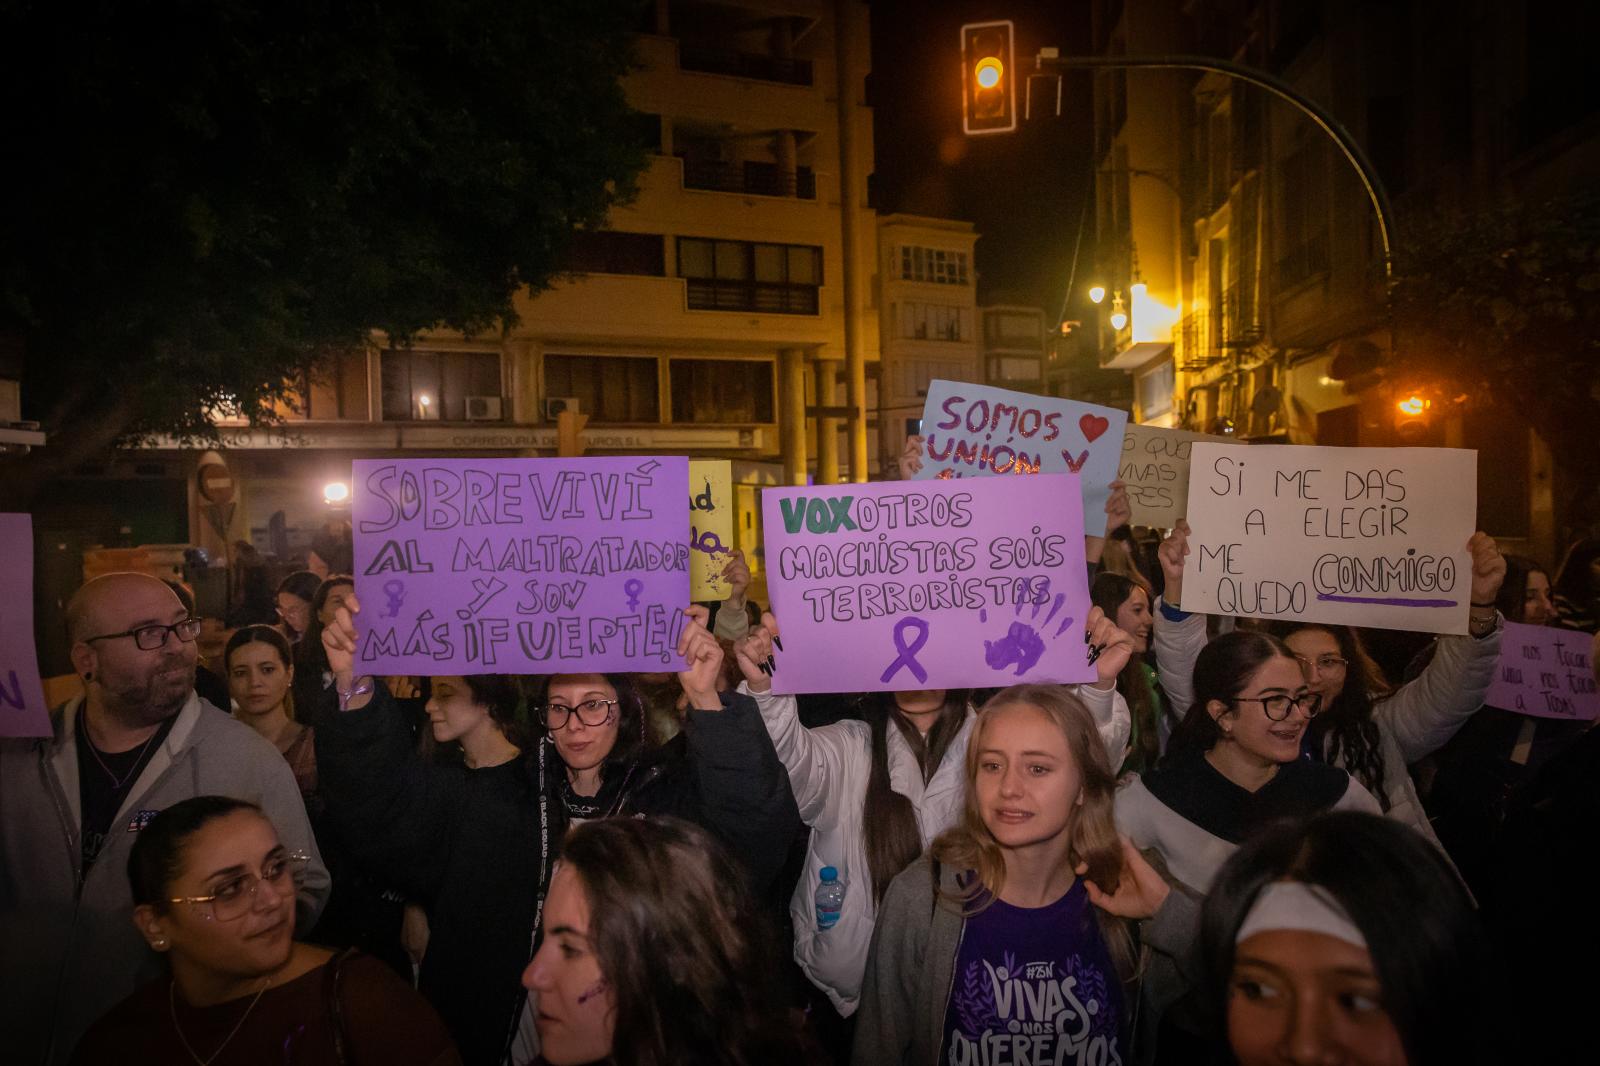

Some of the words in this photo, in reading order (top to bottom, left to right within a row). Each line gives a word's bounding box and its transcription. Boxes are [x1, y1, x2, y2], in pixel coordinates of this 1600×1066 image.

[937, 396, 1062, 441] SOMOS
[927, 433, 1041, 475] UNIÓN
[360, 459, 662, 534] SOBREVIVÍ
[1275, 469, 1322, 500] ME
[1345, 469, 1406, 502] DAS
[1245, 509, 1266, 536] A
[364, 539, 433, 576] AL
[451, 534, 690, 576] MALTRATADOR
[1199, 543, 1243, 575] ME
[468, 576, 508, 614] Y
[1217, 577, 1307, 615] QUEDO
[361, 609, 455, 662] MÁS
[982, 957, 1091, 1044] VIVAS
[948, 1028, 1124, 1066] QUEREMOS
[1022, 1021, 1055, 1036] NOS
